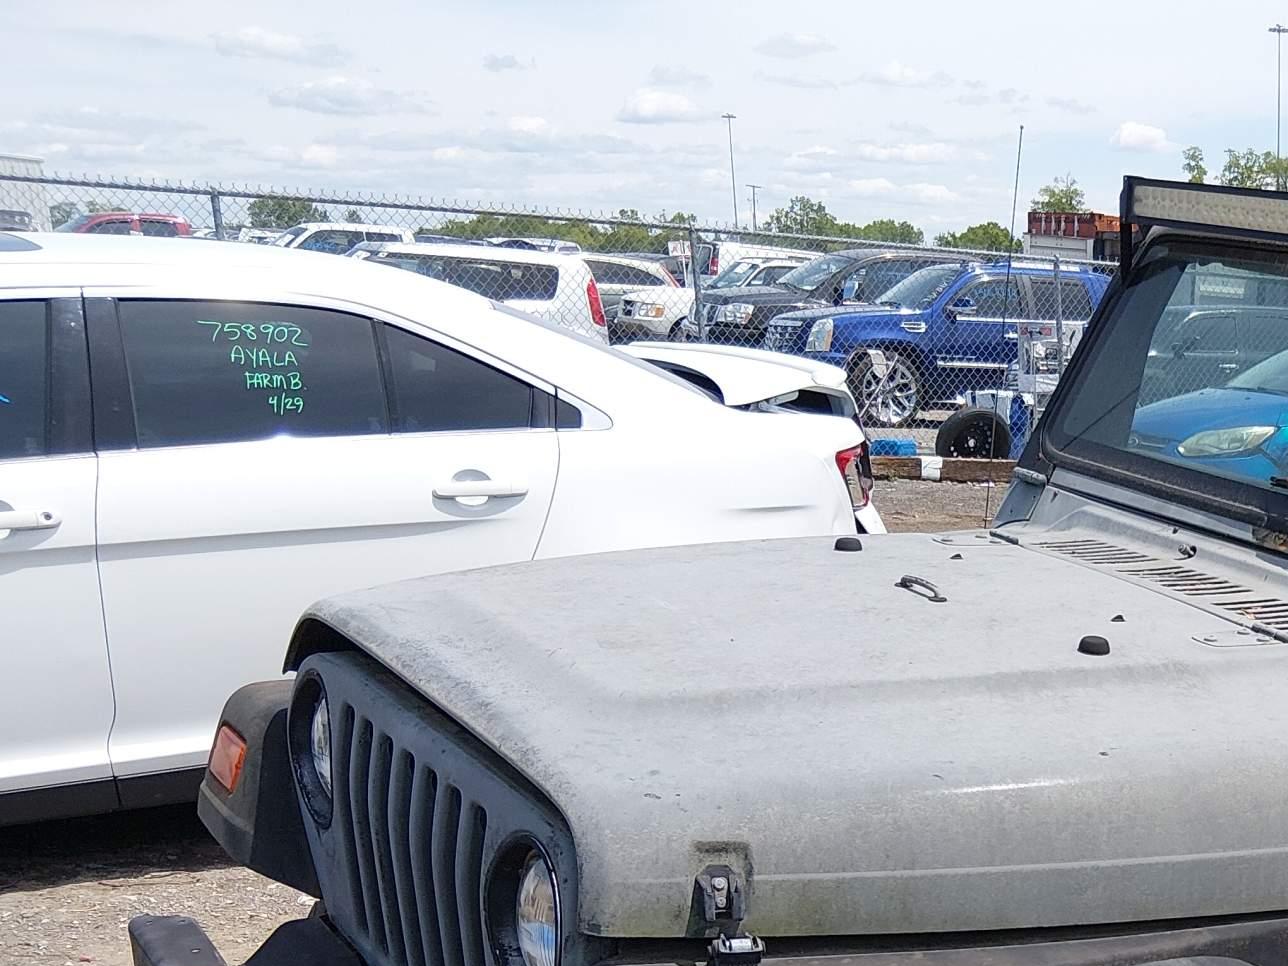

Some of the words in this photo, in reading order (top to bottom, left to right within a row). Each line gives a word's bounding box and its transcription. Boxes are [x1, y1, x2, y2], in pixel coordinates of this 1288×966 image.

[195, 320, 309, 346] 758902
[230, 344, 298, 369] AYALA
[268, 391, 304, 416] 4/29
